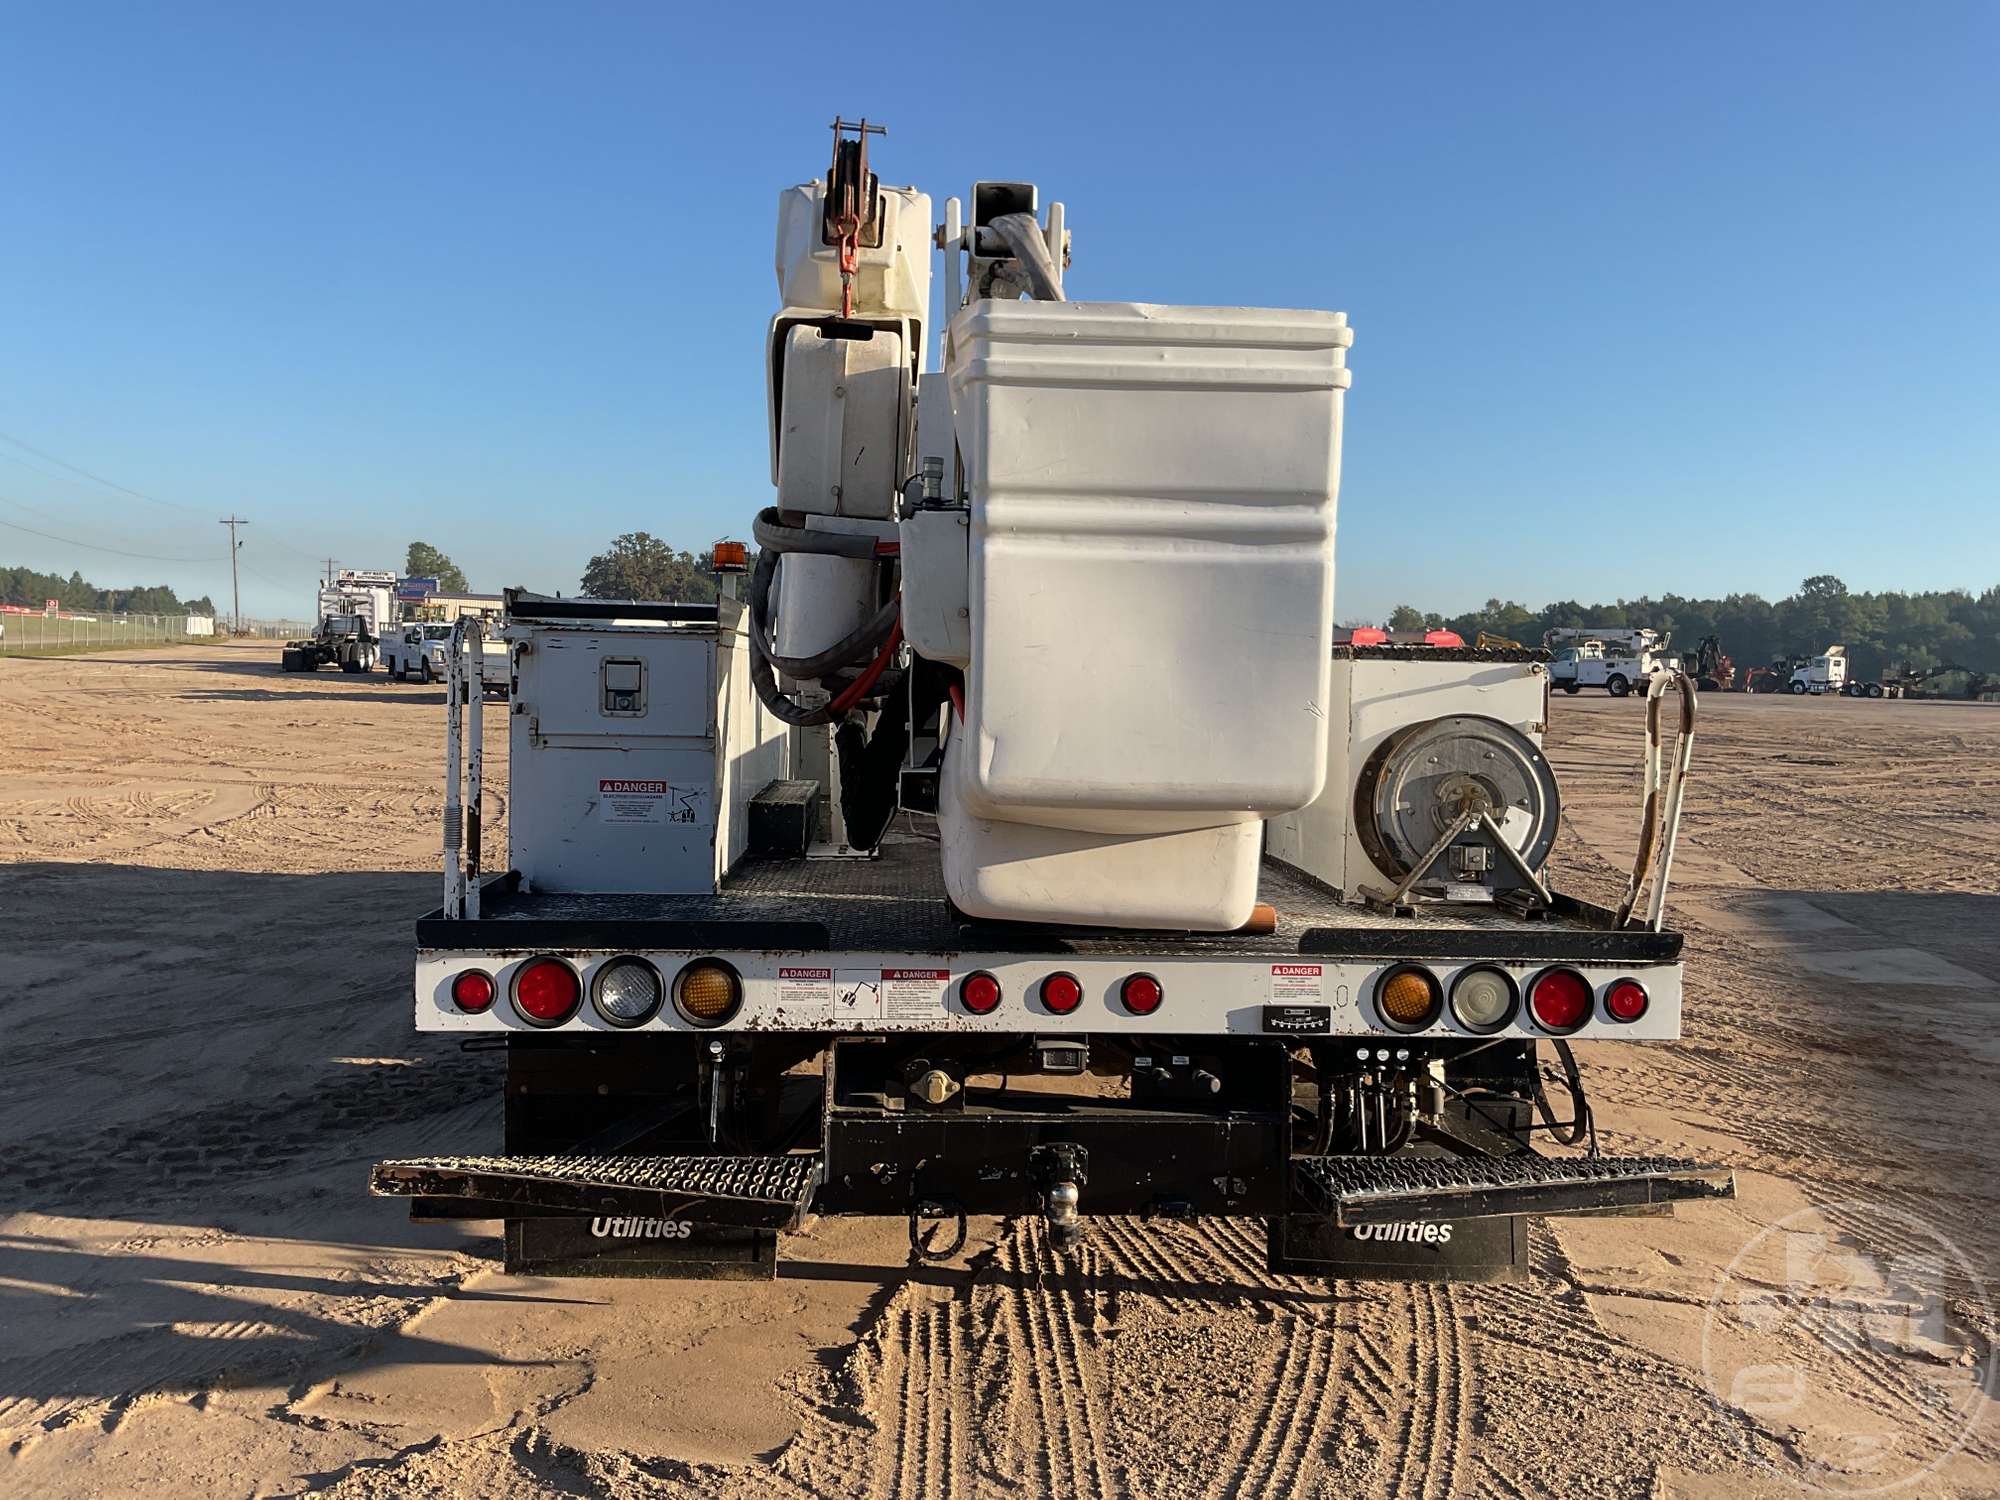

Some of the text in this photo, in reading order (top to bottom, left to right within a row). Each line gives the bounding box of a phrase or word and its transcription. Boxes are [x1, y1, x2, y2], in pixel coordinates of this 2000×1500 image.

[614, 782, 663, 792] DANGER
[789, 970, 828, 978] DANGER
[902, 971, 938, 979] DANGER
[1282, 967, 1320, 975] DANGER
[591, 1216, 693, 1238] Utilities
[1353, 1221, 1453, 1243] Utilities
